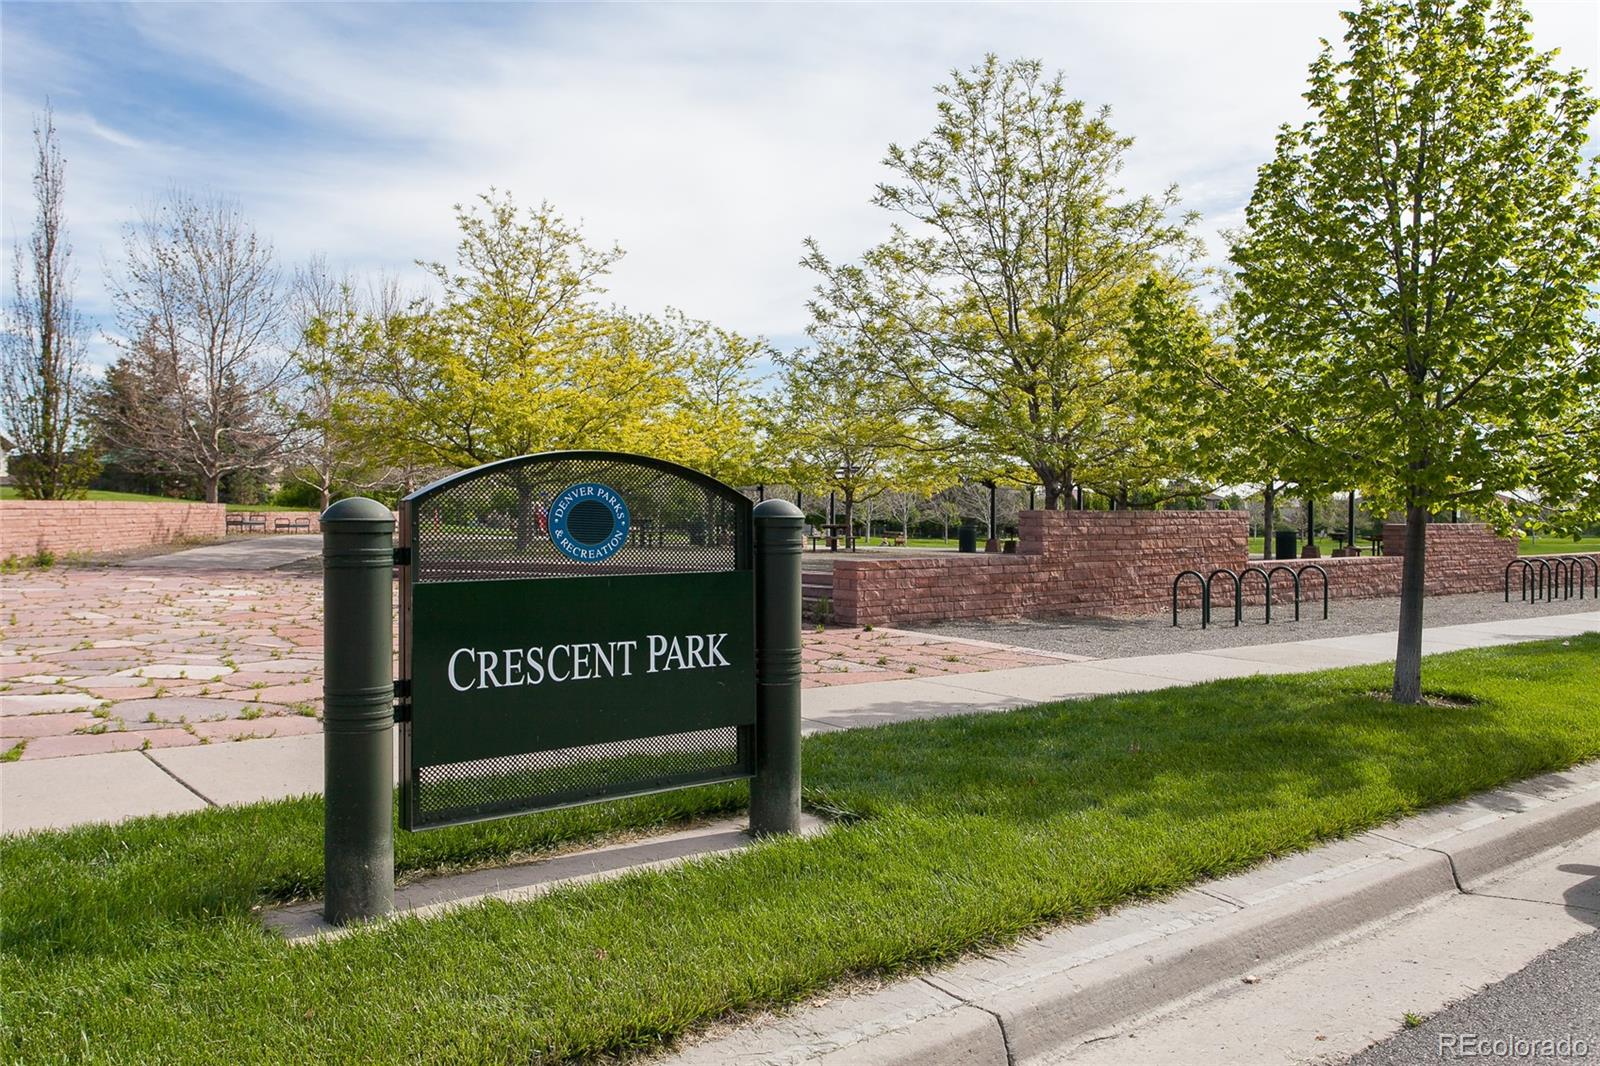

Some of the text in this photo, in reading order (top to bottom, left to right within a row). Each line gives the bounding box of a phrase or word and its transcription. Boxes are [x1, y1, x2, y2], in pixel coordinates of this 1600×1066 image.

[555, 486, 625, 520] DENVER PARKS
[554, 529, 624, 559] & RECREATION
[447, 633, 731, 692] CRESCENT PARK
